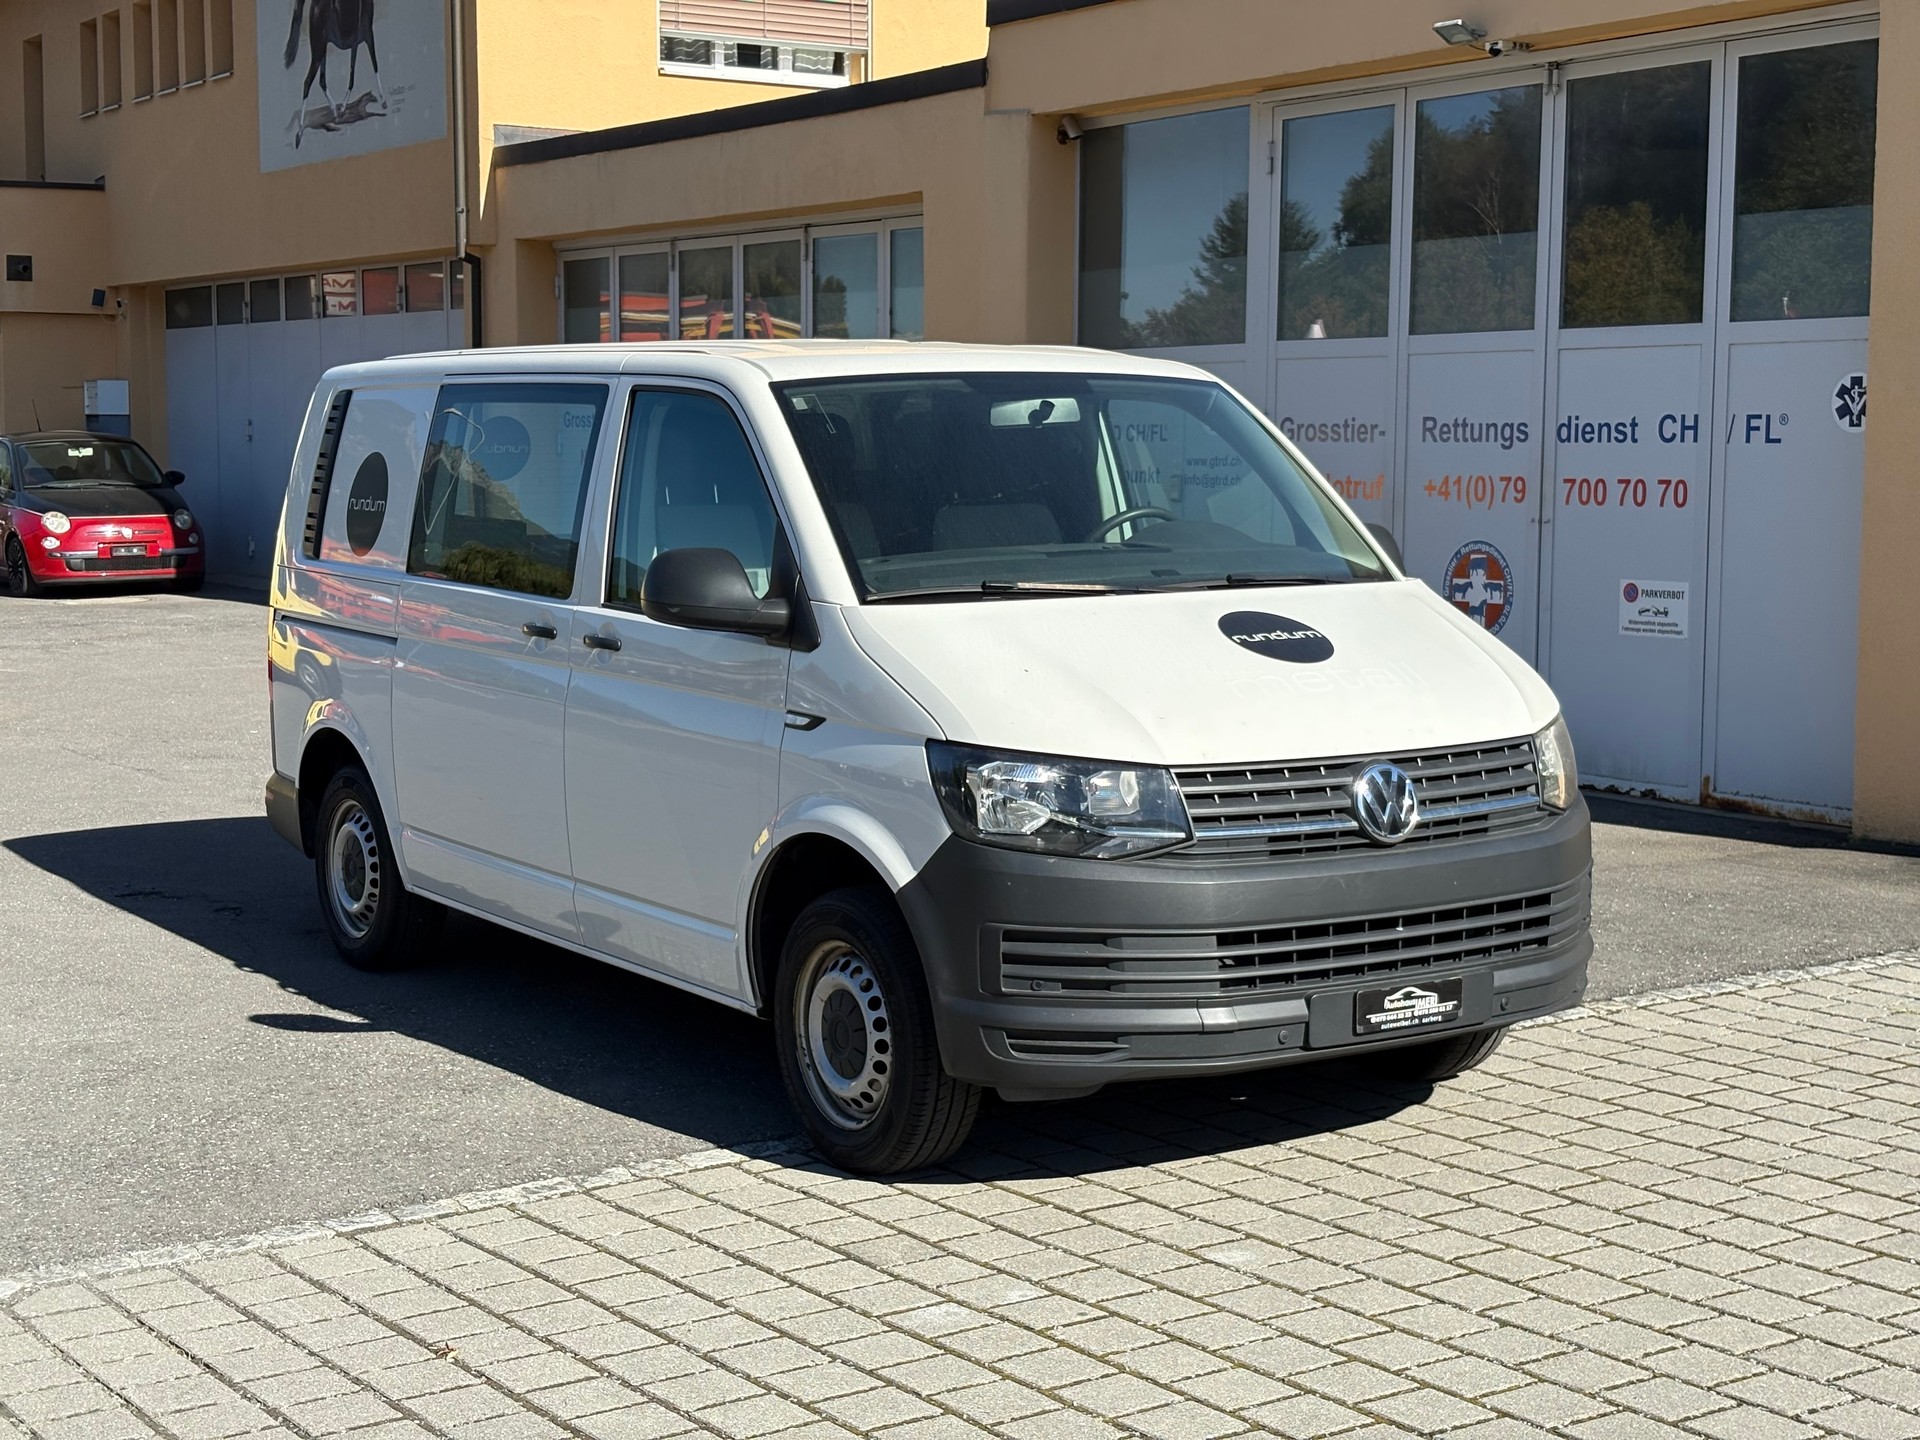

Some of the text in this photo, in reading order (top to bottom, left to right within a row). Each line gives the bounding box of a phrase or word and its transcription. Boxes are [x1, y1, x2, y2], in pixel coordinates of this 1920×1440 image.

[564, 411, 594, 429] Gross
[1280, 416, 1386, 443] Grosstier-
[1421, 416, 1529, 450] Rettungs
[1556, 415, 1639, 444] dienst
[1657, 413, 1700, 444] CH
[1562, 478, 1607, 507] 700
[1616, 478, 1647, 508] 70
[1657, 479, 1688, 509] 70
[349, 496, 386, 513] rundum
[1640, 589, 1685, 600] PARKVERBOT
[1231, 629, 1323, 644] rundum
